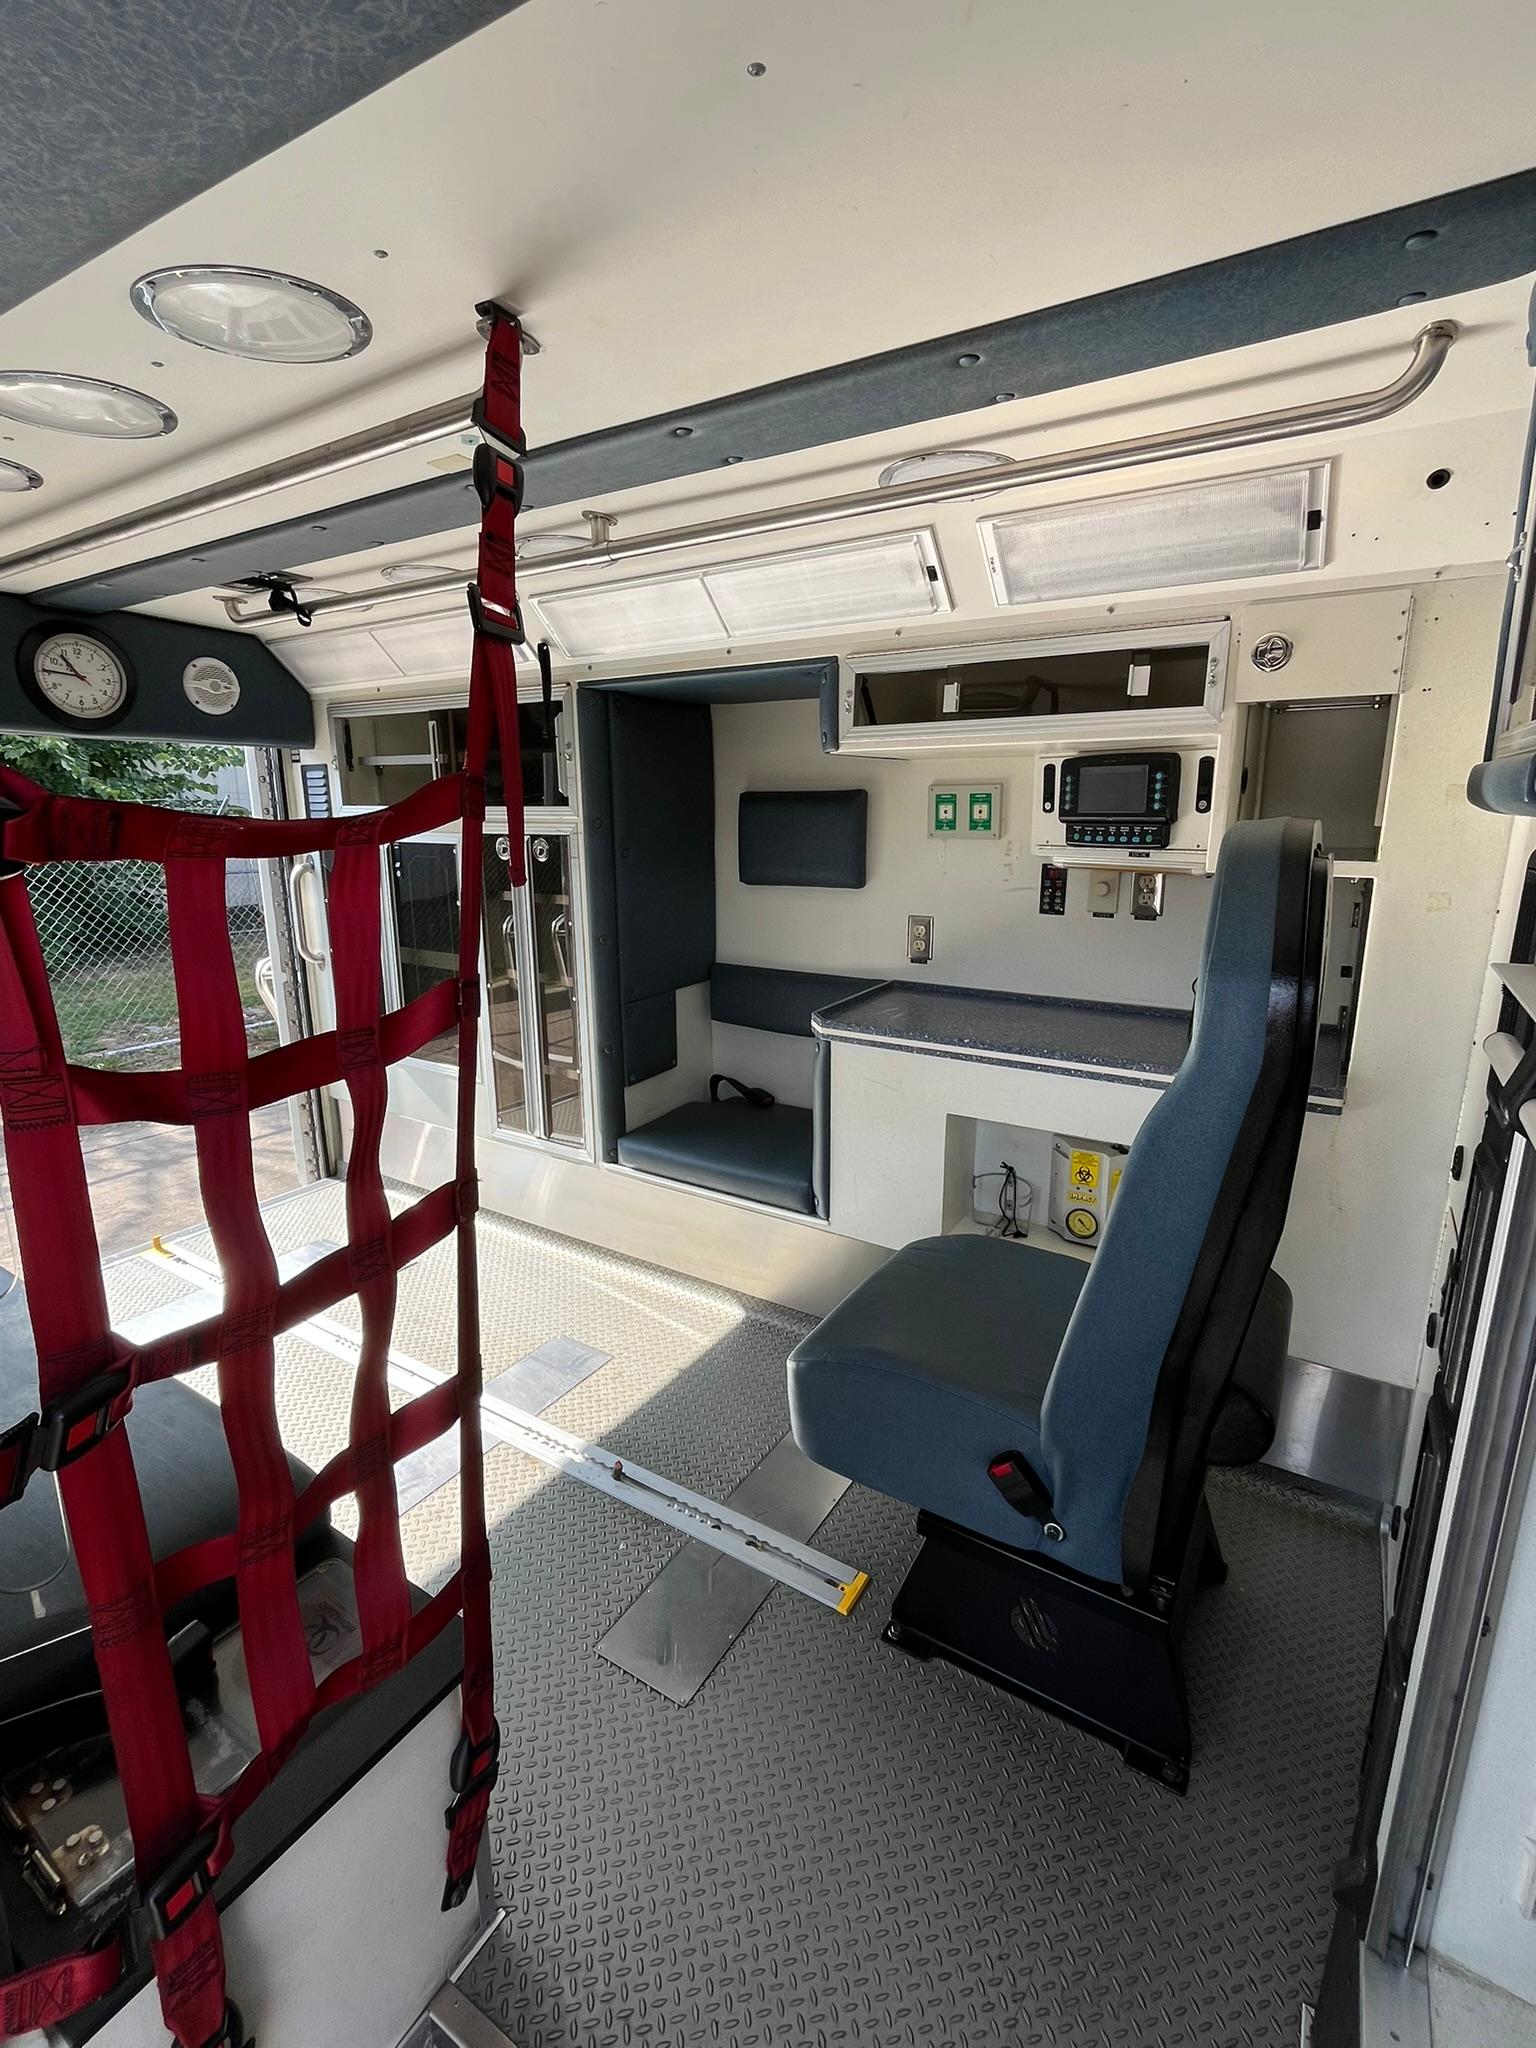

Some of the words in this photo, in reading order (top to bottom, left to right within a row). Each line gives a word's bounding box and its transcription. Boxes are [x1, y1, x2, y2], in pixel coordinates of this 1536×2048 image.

[73, 647, 82, 656] 12
[49, 657, 58, 665] 10
[65, 692, 70, 700] 7
